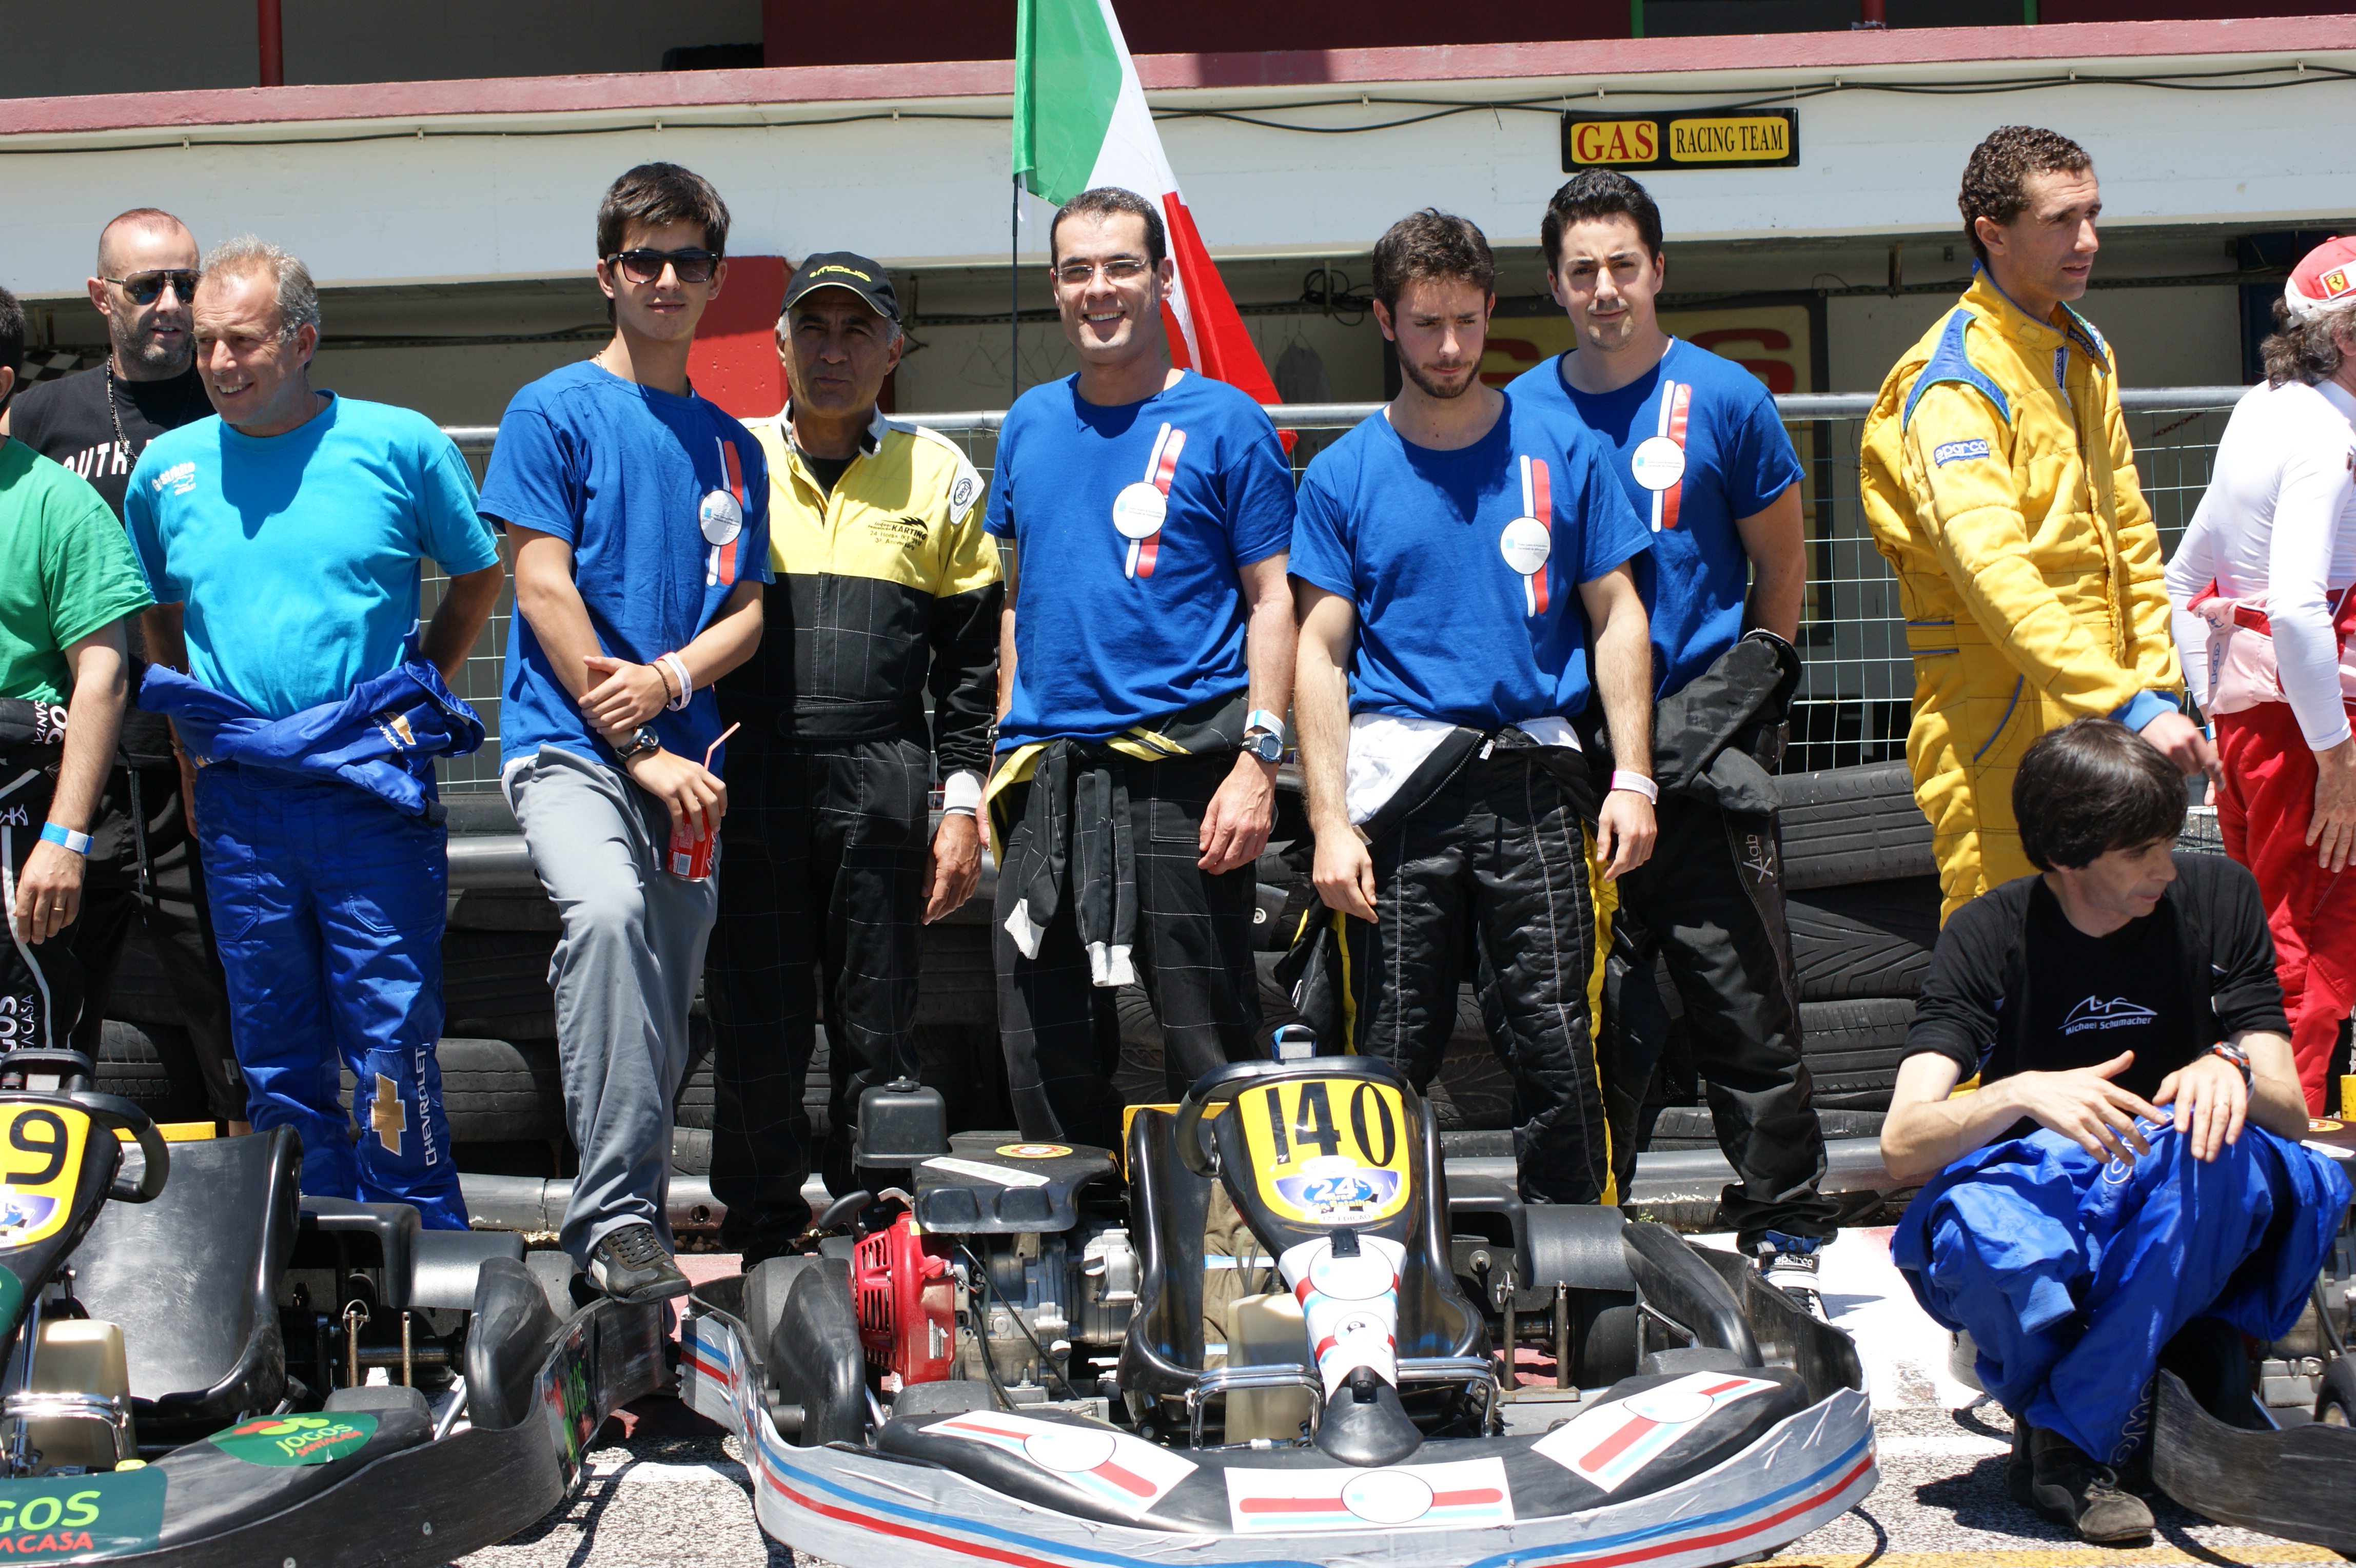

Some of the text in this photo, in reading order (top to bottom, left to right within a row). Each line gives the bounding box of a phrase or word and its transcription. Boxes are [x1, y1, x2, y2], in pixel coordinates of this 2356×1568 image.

[1577, 123, 1783, 161] GAS RACING TEAM
[1935, 441, 1987, 459] sparco
[891, 524, 928, 540] KARTING
[369, 715, 403, 753] HEVROLE
[2066, 1016, 2152, 1035] Michael Schumacher
[416, 1048, 437, 1166] CHEVROLET
[1265, 1081, 1396, 1167] 140
[5, 1109, 68, 1185] 9
[1311, 1177, 1359, 1201] 24
[276, 1424, 354, 1457] JOGOS
